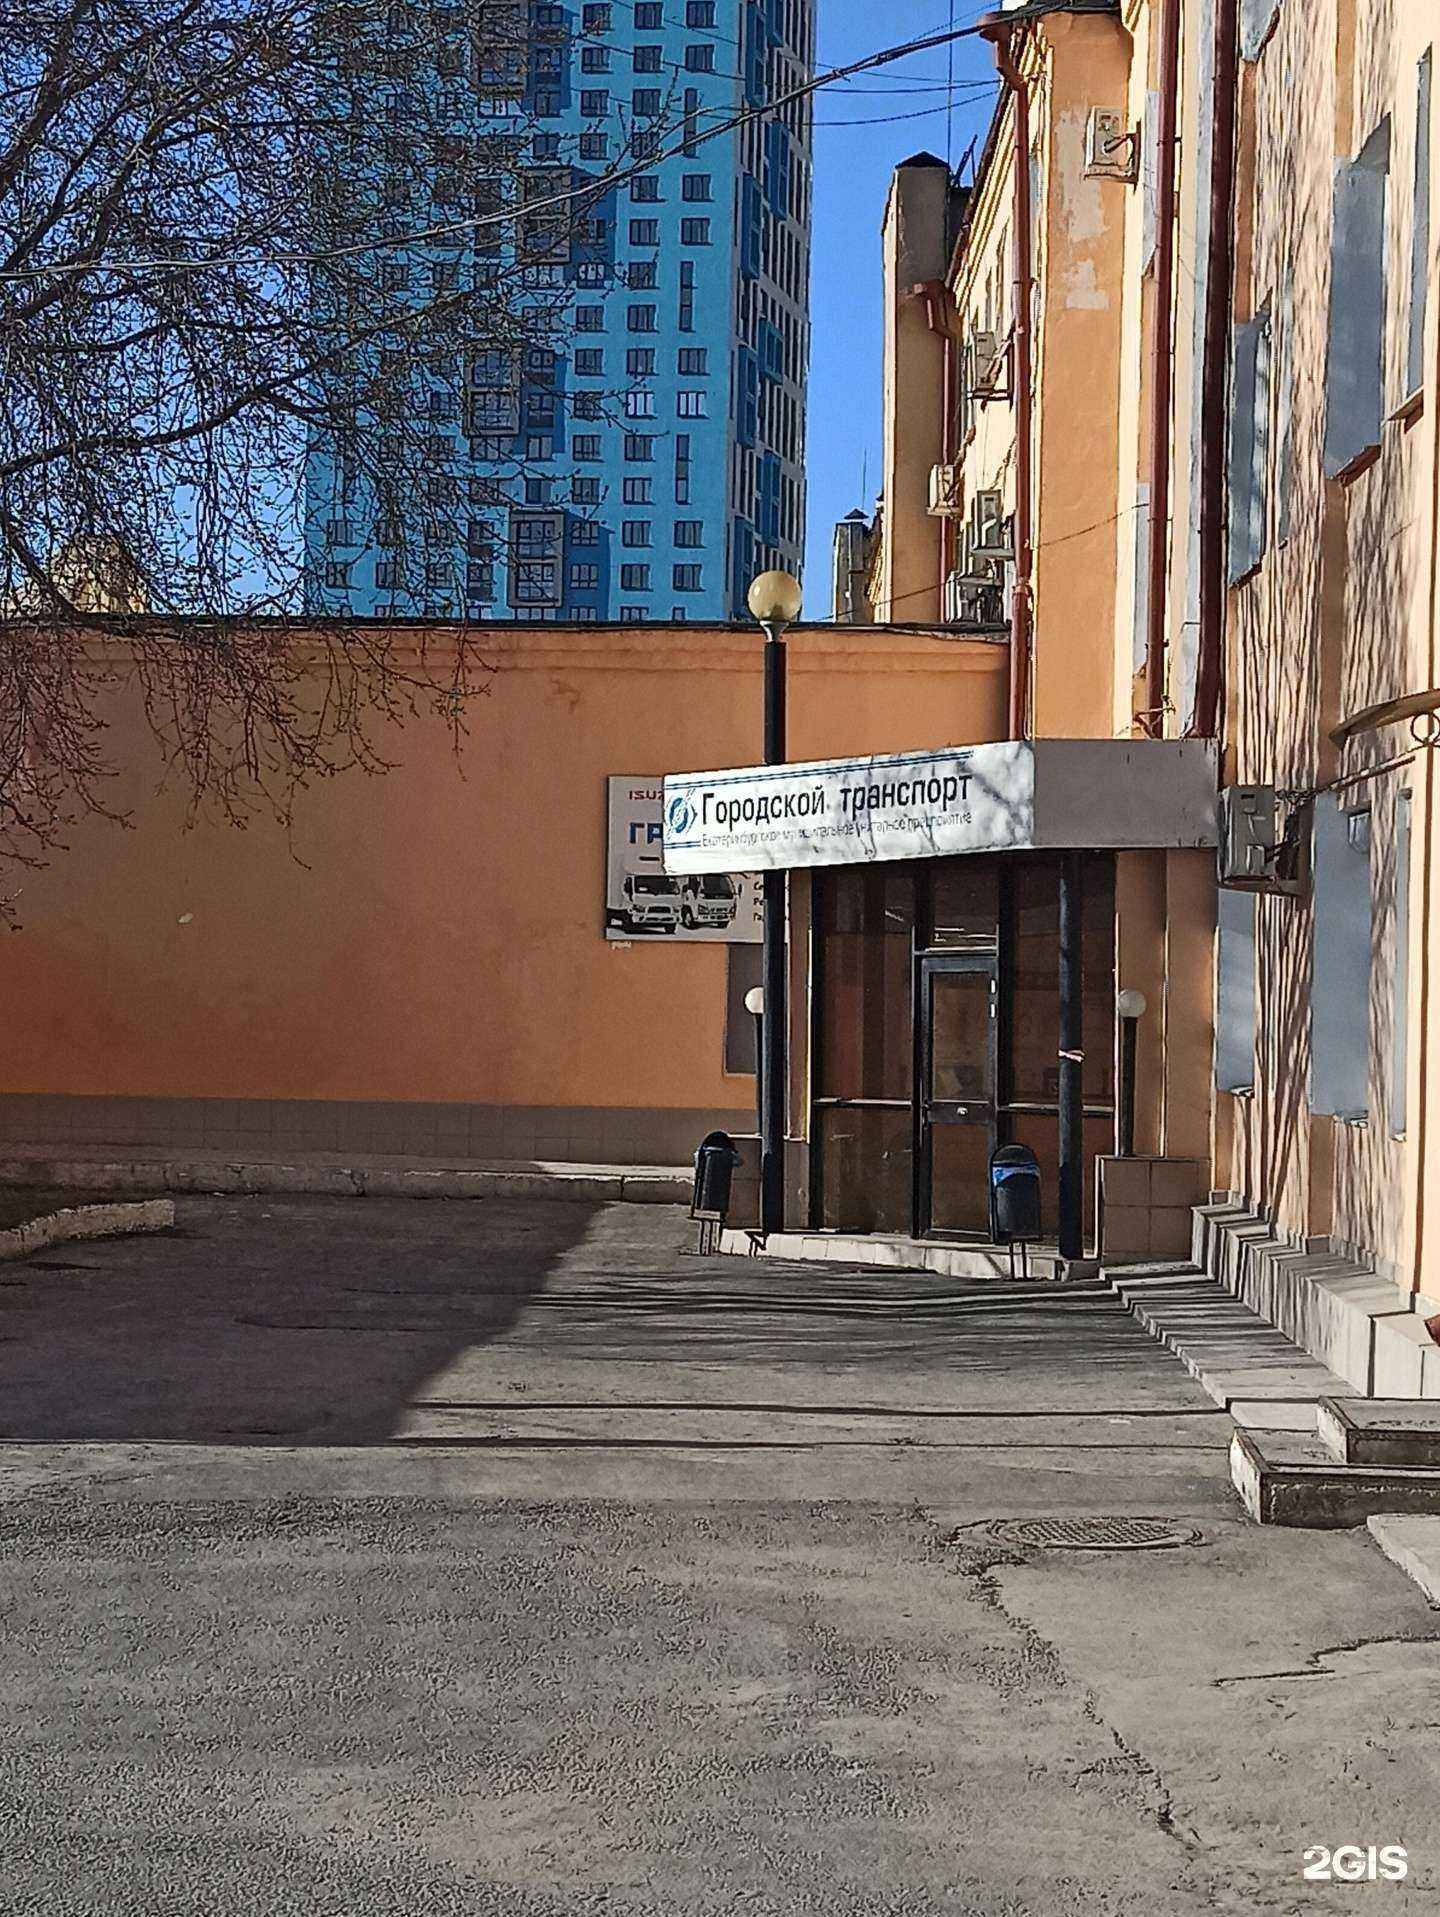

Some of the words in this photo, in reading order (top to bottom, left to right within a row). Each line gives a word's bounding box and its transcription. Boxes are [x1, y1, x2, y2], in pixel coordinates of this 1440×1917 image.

[629, 789, 664, 801] ISUZ
[702, 784, 826, 832] Городской
[839, 774, 973, 822] транспорт
[629, 822, 664, 844] ГР
